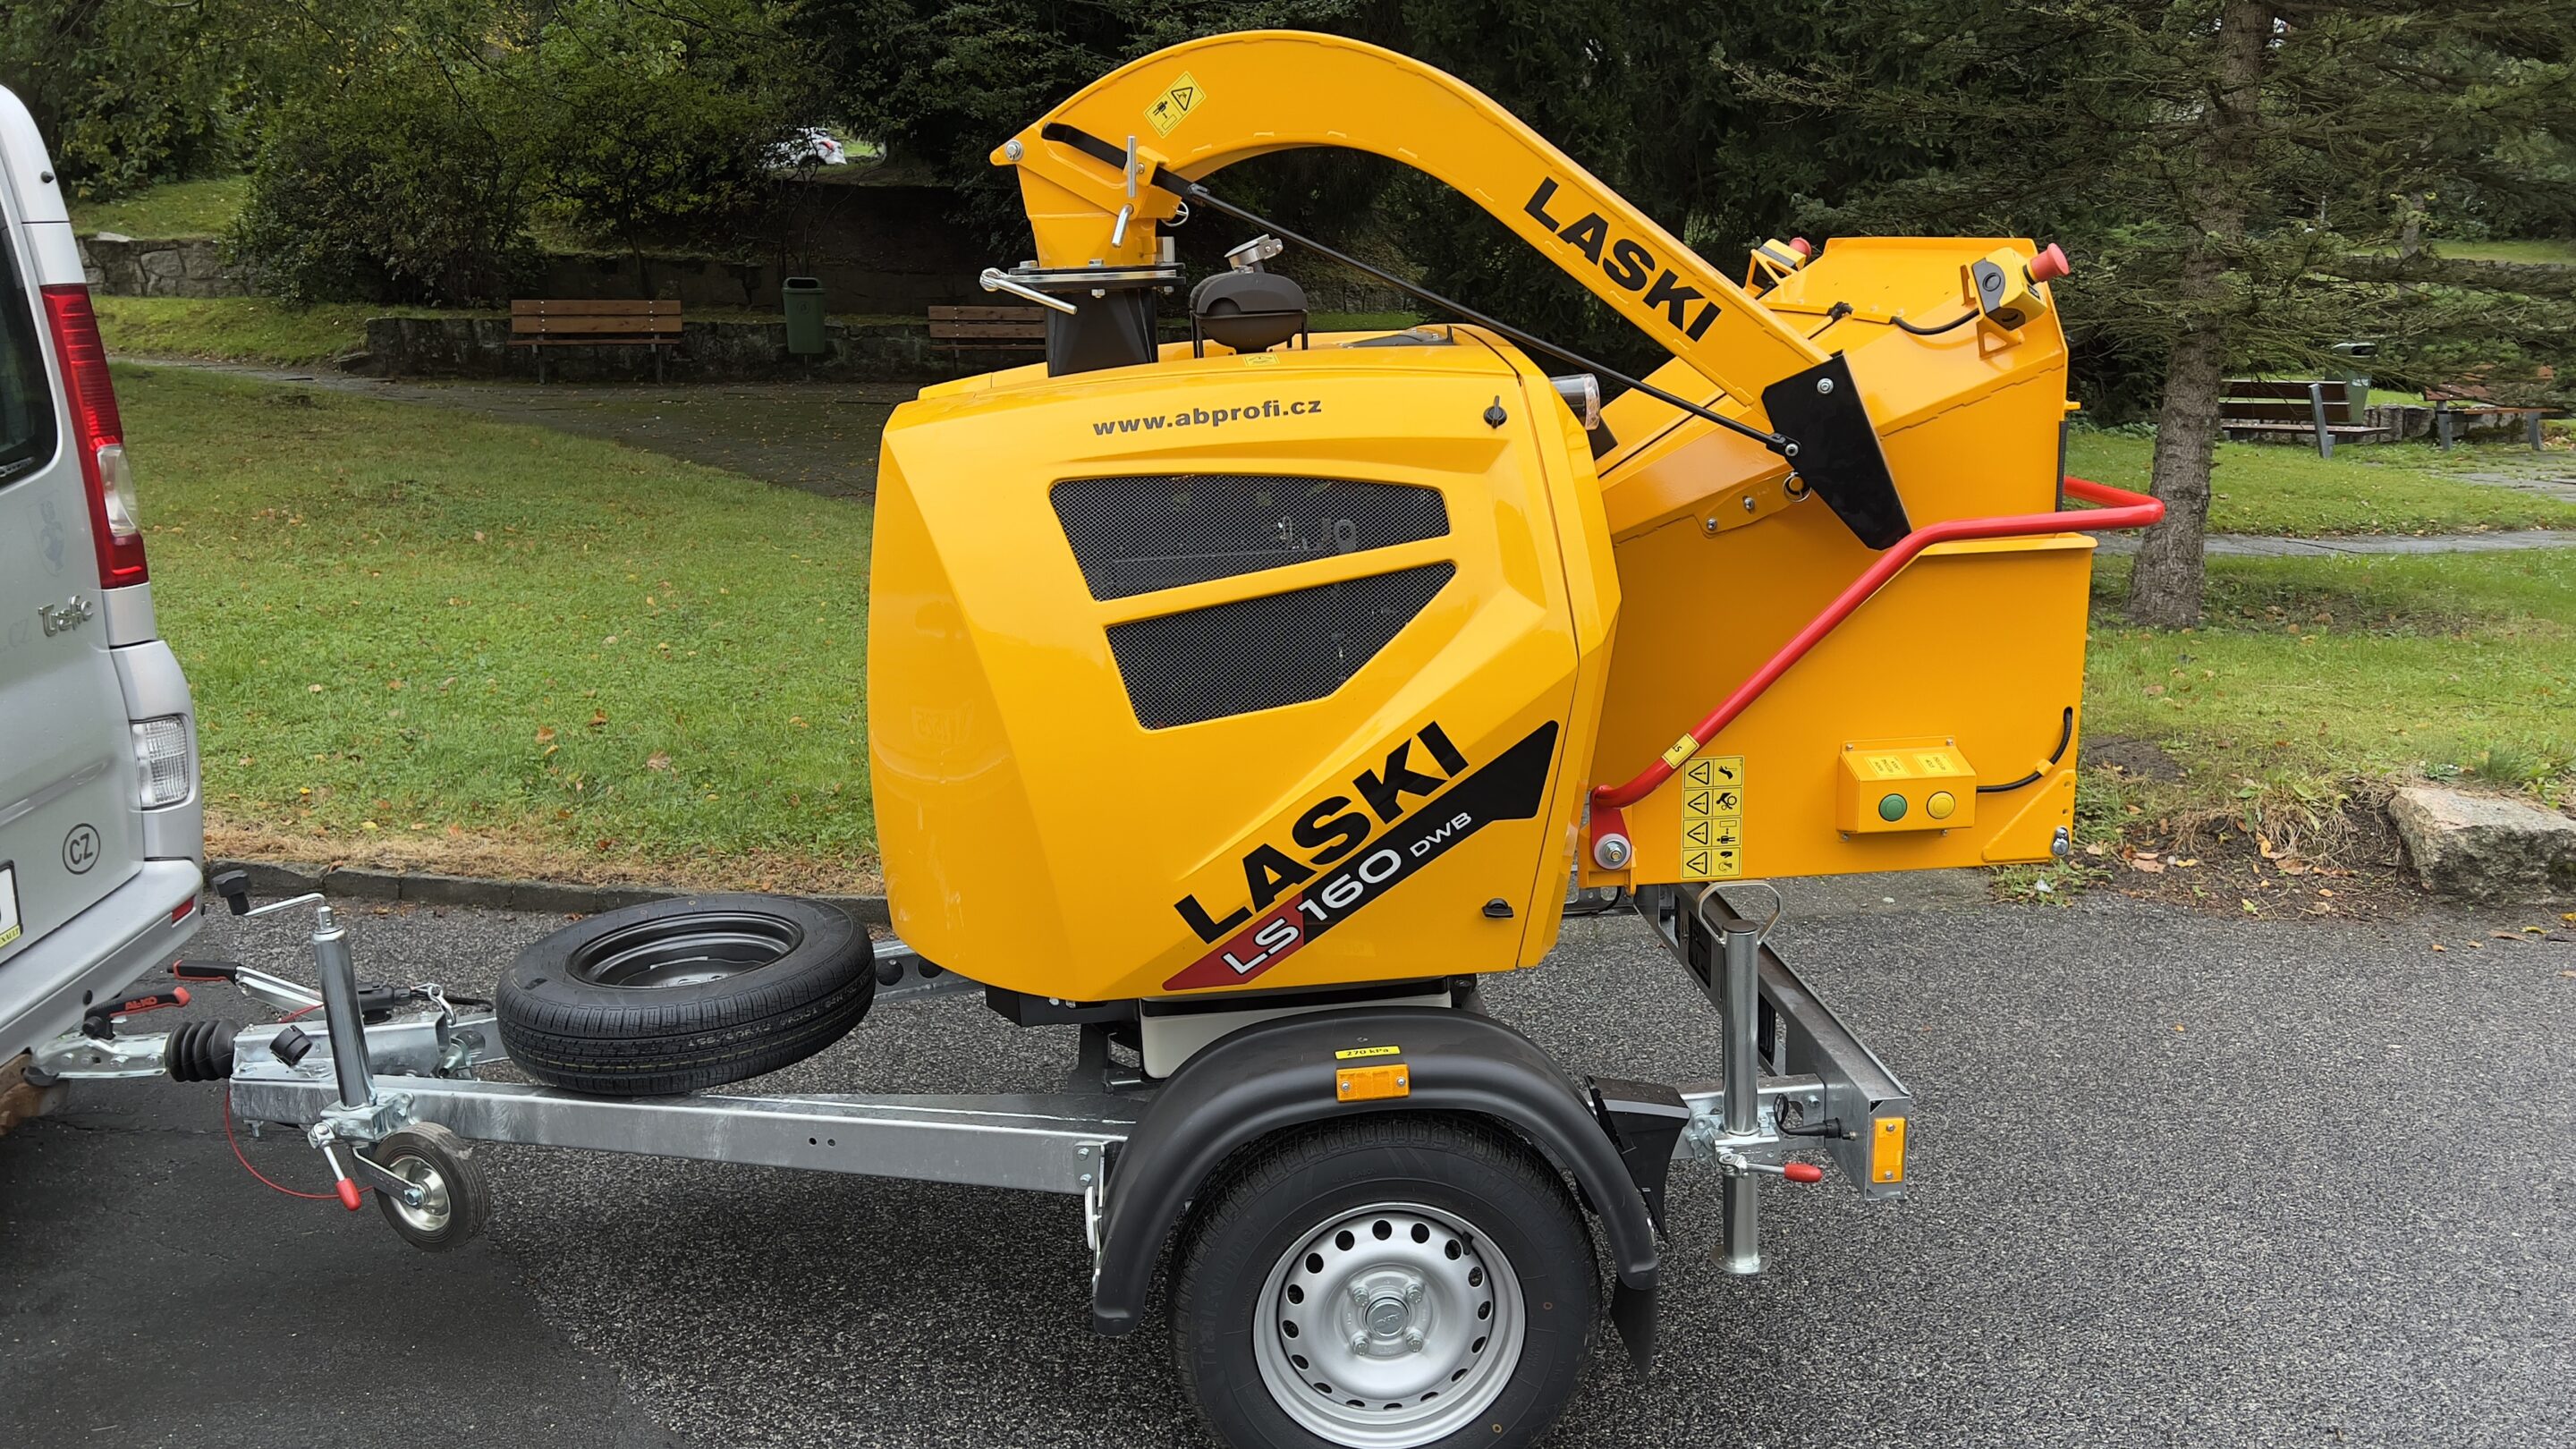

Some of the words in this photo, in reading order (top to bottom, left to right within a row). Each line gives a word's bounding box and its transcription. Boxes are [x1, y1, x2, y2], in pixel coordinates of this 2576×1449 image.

[1523, 176, 1722, 343] LASKI
[1093, 400, 1322, 436] www.abprofi.cz
[38, 595, 94, 638] Trafic
[70, 833, 93, 865] CZ
[1174, 721, 1470, 945] LASKI
[1410, 811, 1472, 858] DWB
